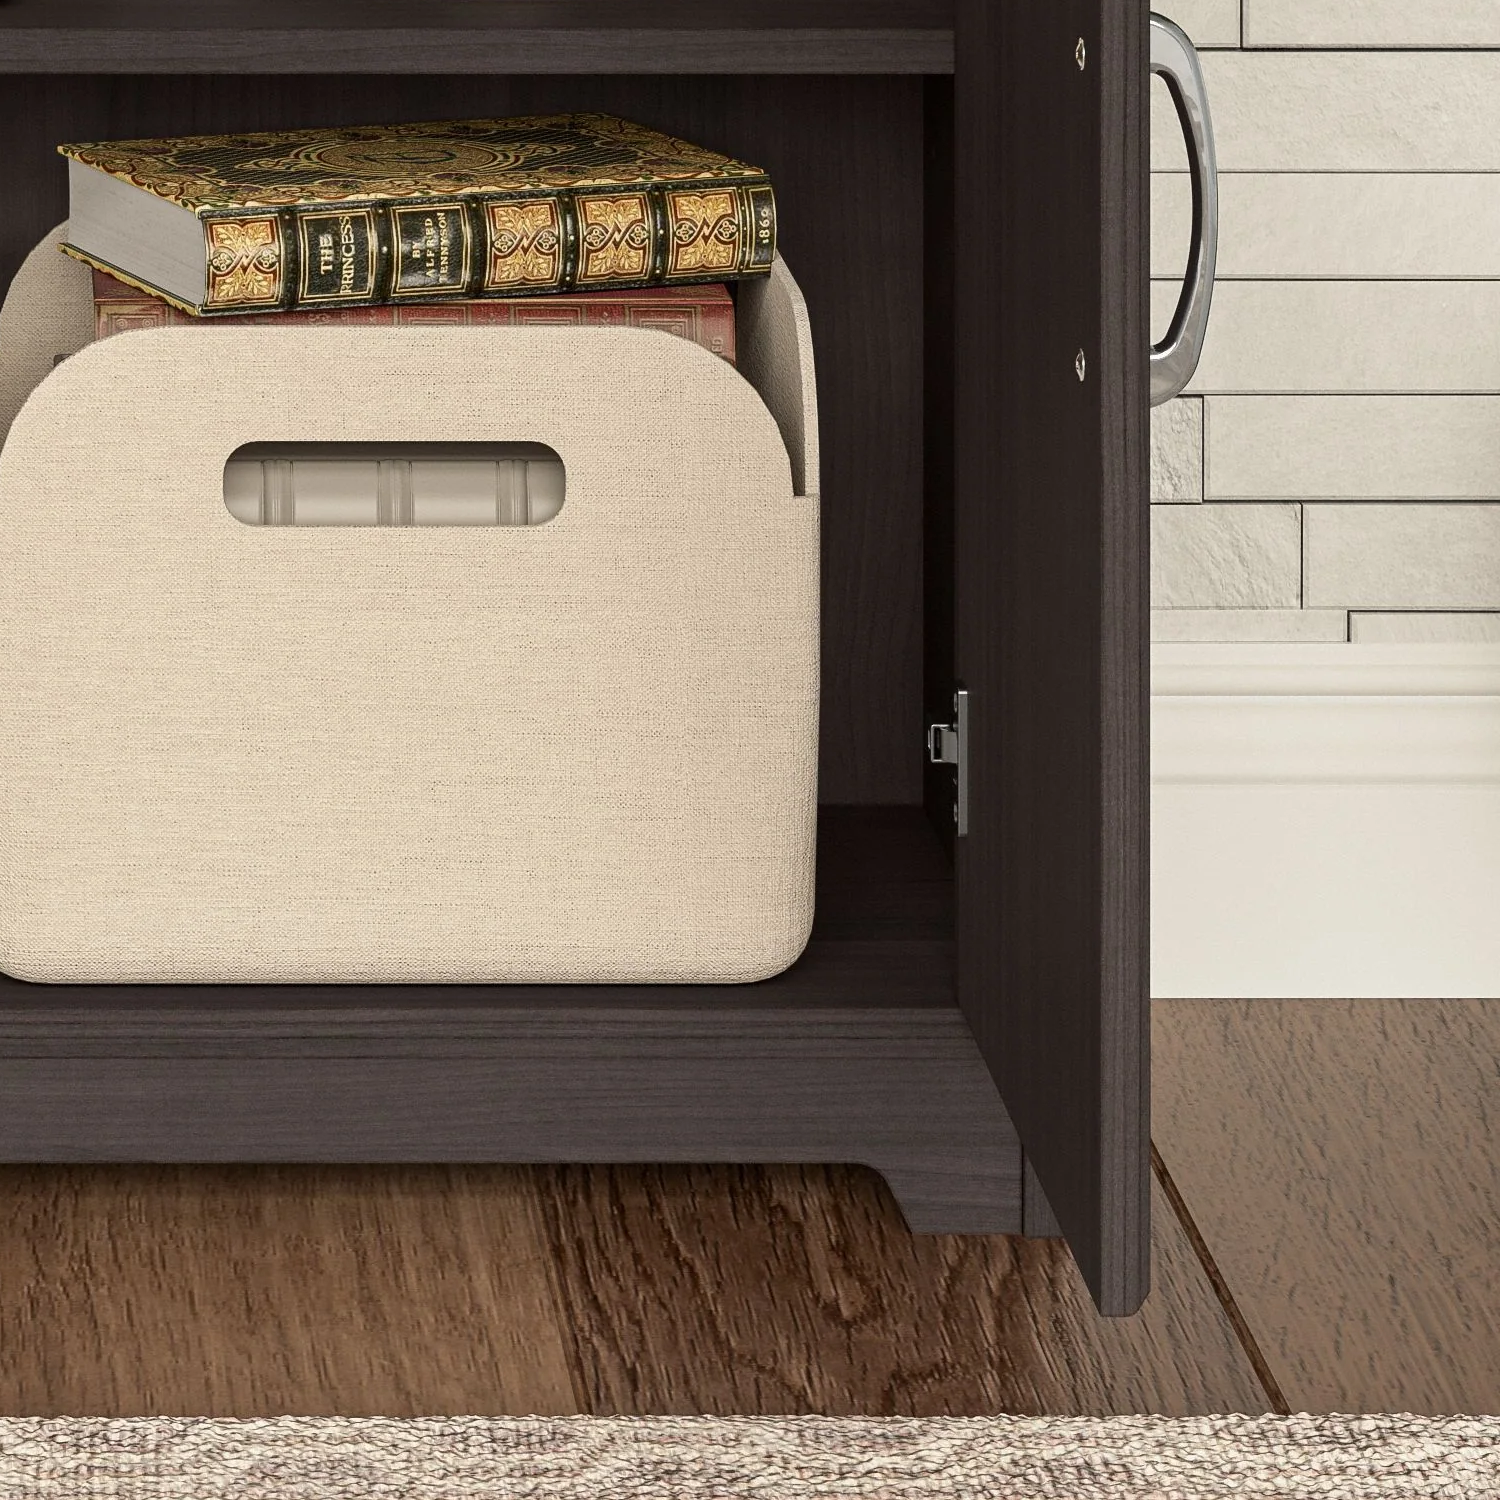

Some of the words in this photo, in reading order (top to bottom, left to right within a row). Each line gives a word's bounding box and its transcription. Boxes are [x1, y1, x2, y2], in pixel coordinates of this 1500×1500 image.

[319, 233, 333, 275] THE
[412, 240, 422, 259] BY
[425, 217, 436, 278] ALFRED
[437, 212, 450, 284] TENNYSON
